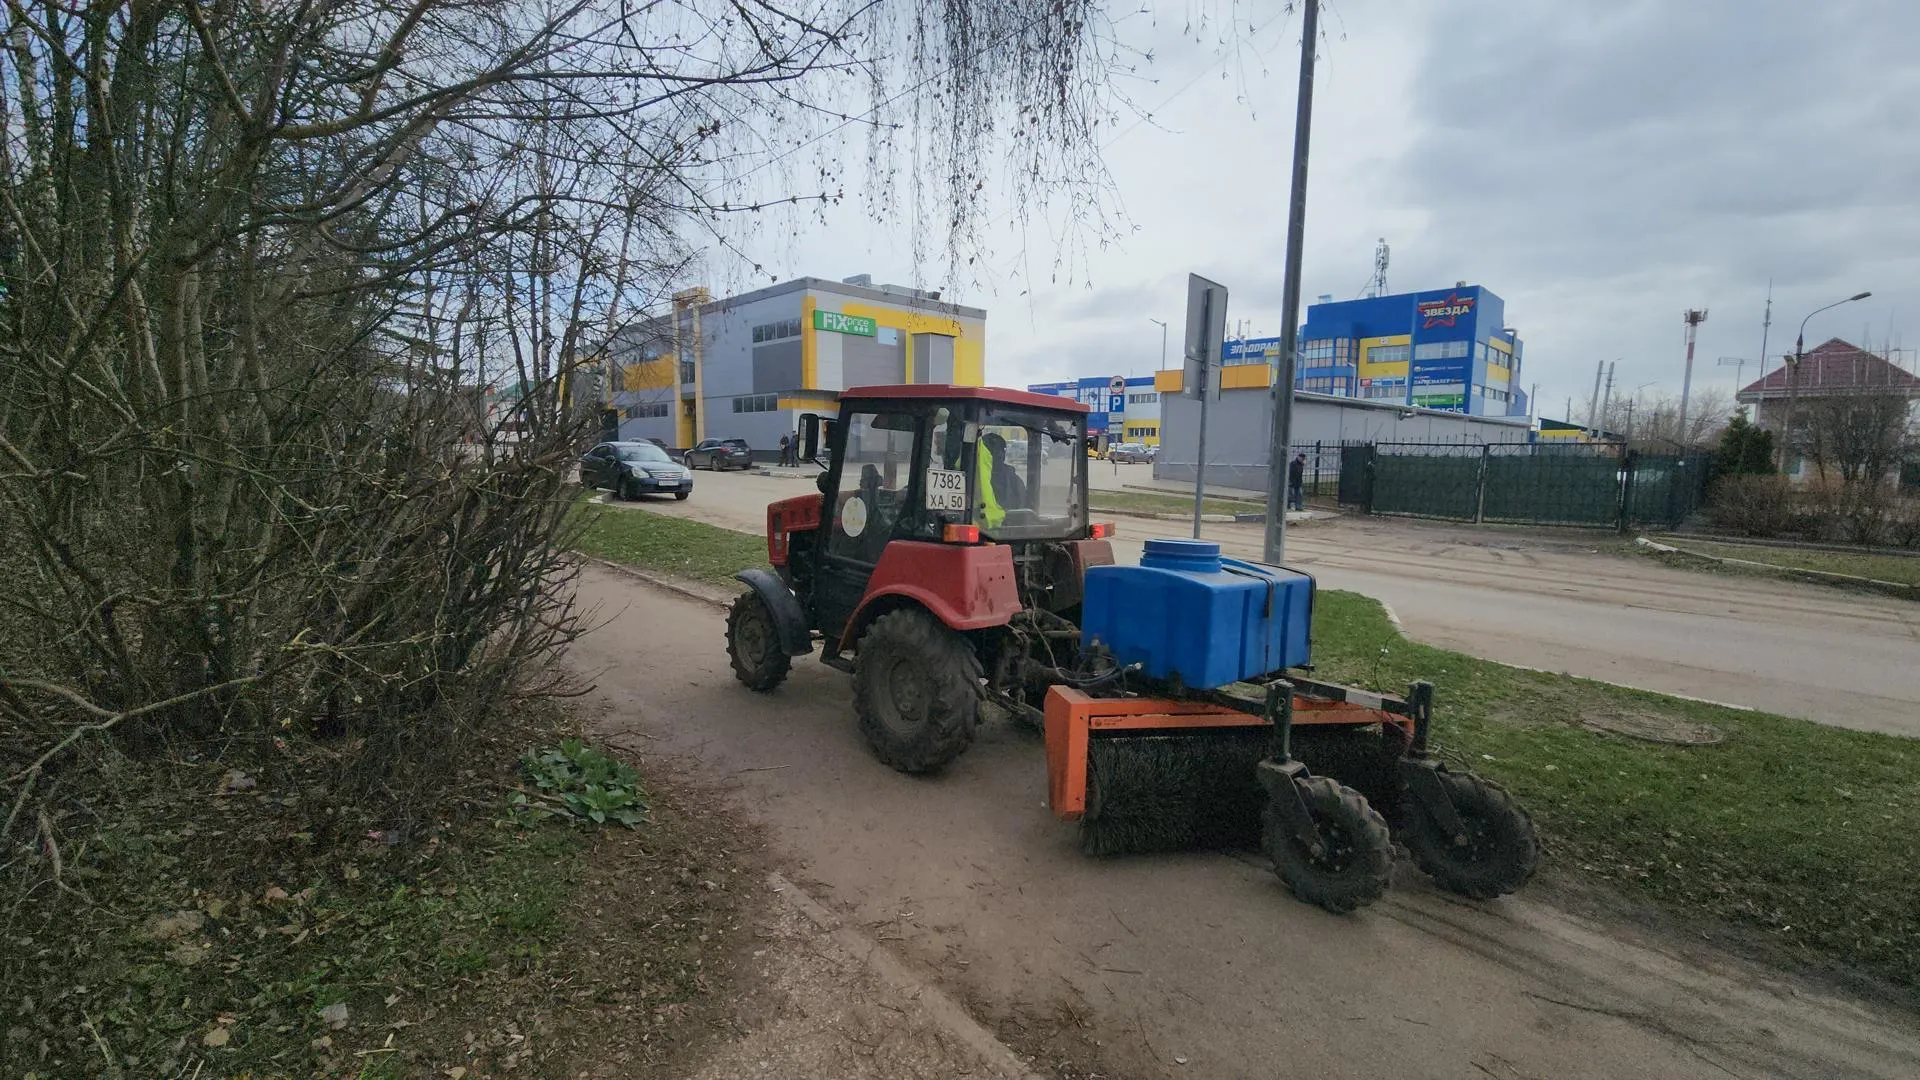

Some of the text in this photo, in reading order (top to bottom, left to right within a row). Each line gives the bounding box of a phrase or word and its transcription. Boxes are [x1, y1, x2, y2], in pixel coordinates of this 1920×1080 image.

[1424, 305, 1470, 317] ЗВЕЗДА
[1112, 396, 1121, 411] P
[932, 472, 961, 489] 7382
[951, 496, 963, 508] 50
